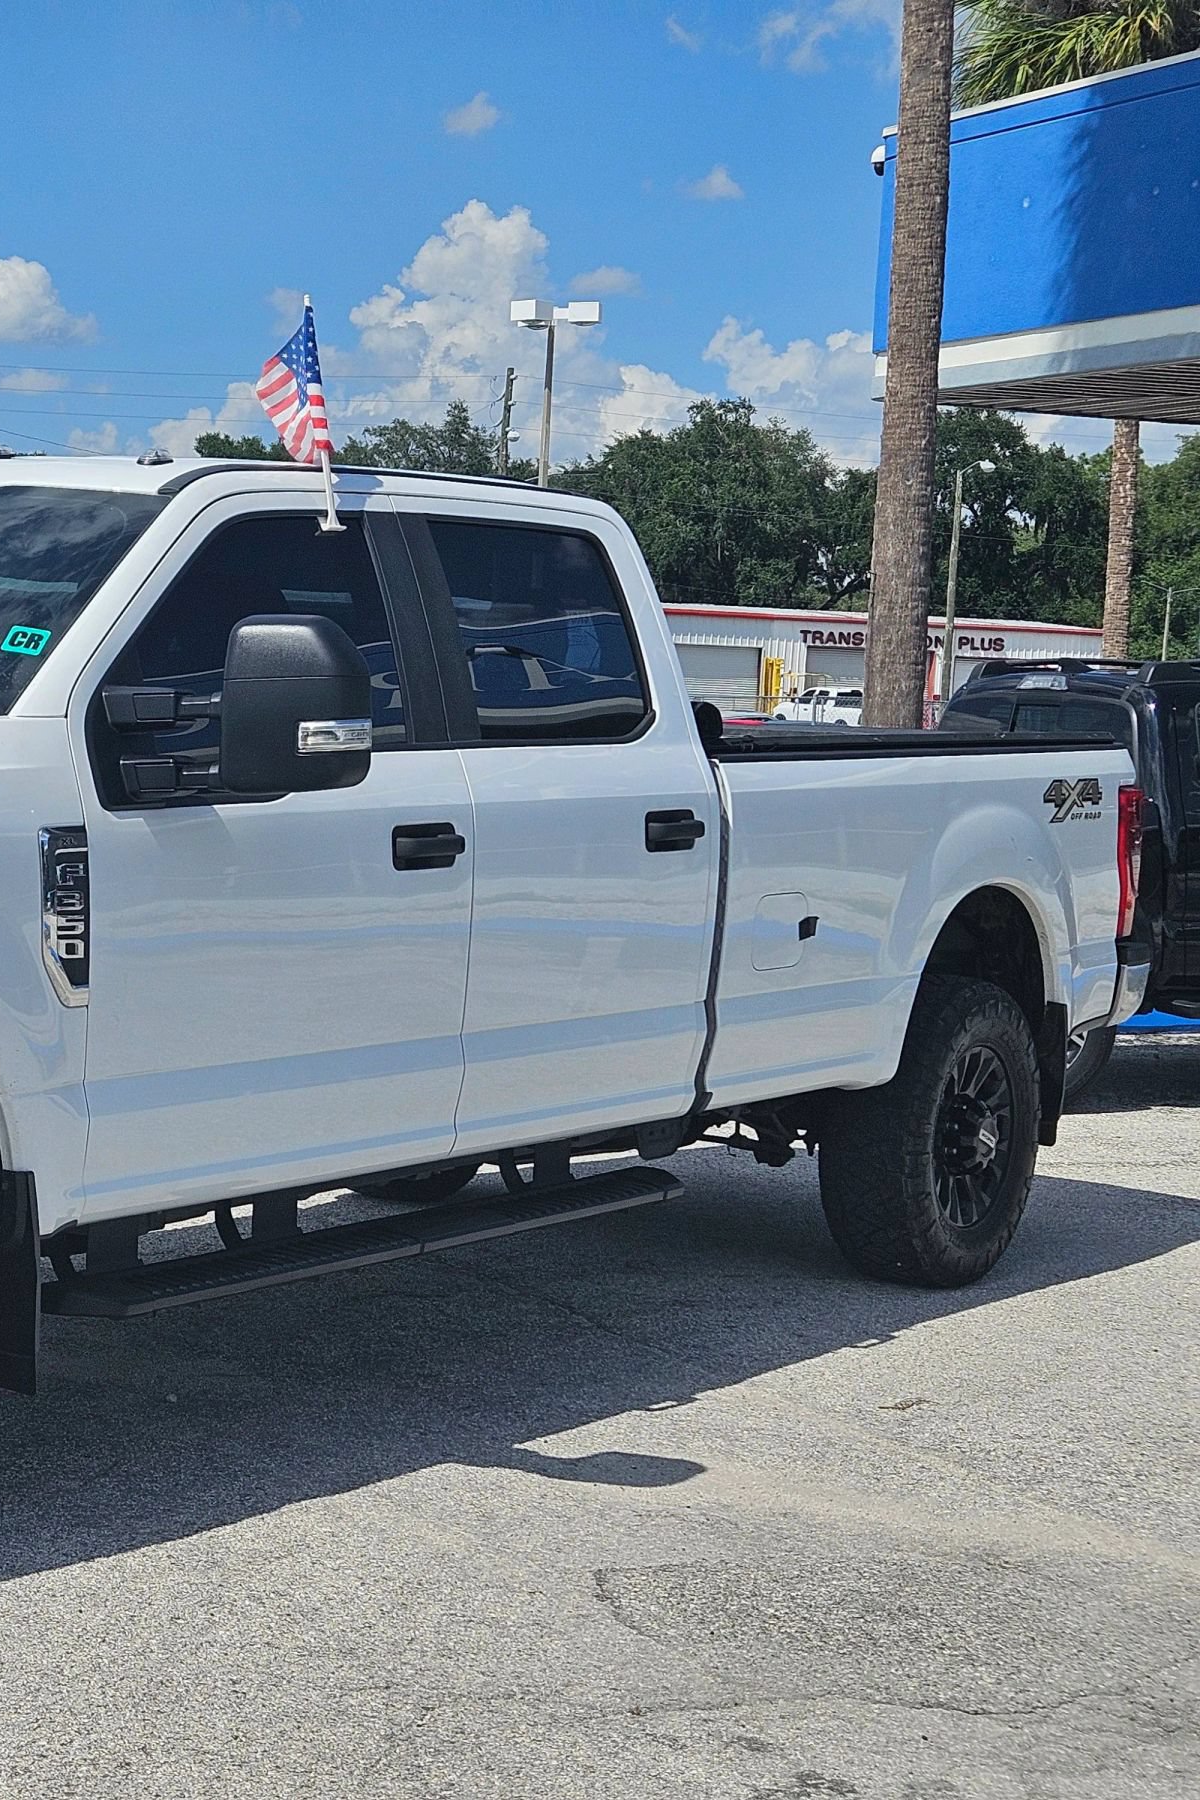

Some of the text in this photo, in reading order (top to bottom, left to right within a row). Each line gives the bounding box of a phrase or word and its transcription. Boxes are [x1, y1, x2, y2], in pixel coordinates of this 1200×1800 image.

[8, 631, 45, 650] CR
[958, 636, 1005, 652] PLUS
[1070, 811, 1102, 820] OFF ROAD
